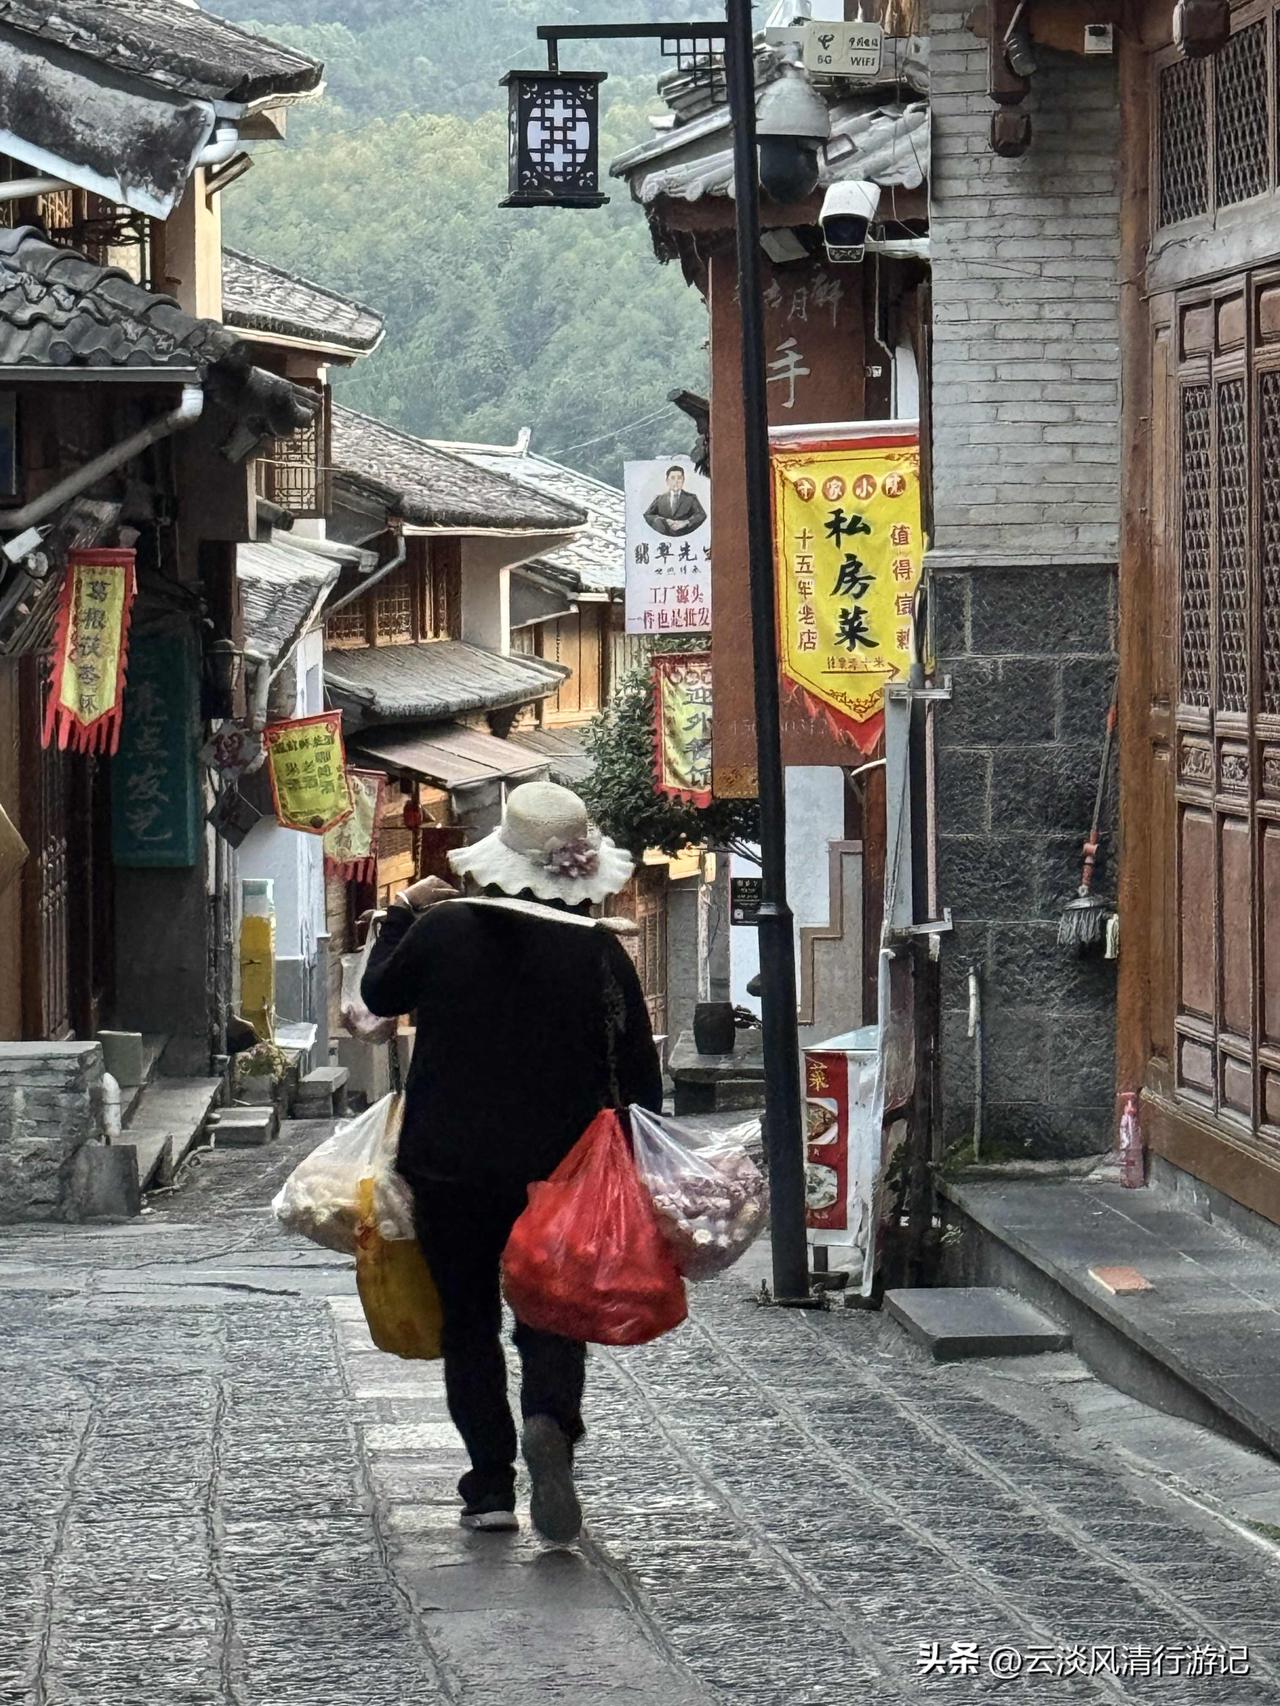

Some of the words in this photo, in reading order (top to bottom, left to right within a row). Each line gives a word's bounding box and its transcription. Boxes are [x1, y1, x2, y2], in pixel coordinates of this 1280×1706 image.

[650, 584, 703, 604] 工厂源头
[794, 528, 817, 651] 十五年老店
[824, 508, 881, 652] 私房菜
[628, 607, 710, 629] 一件也是批发
